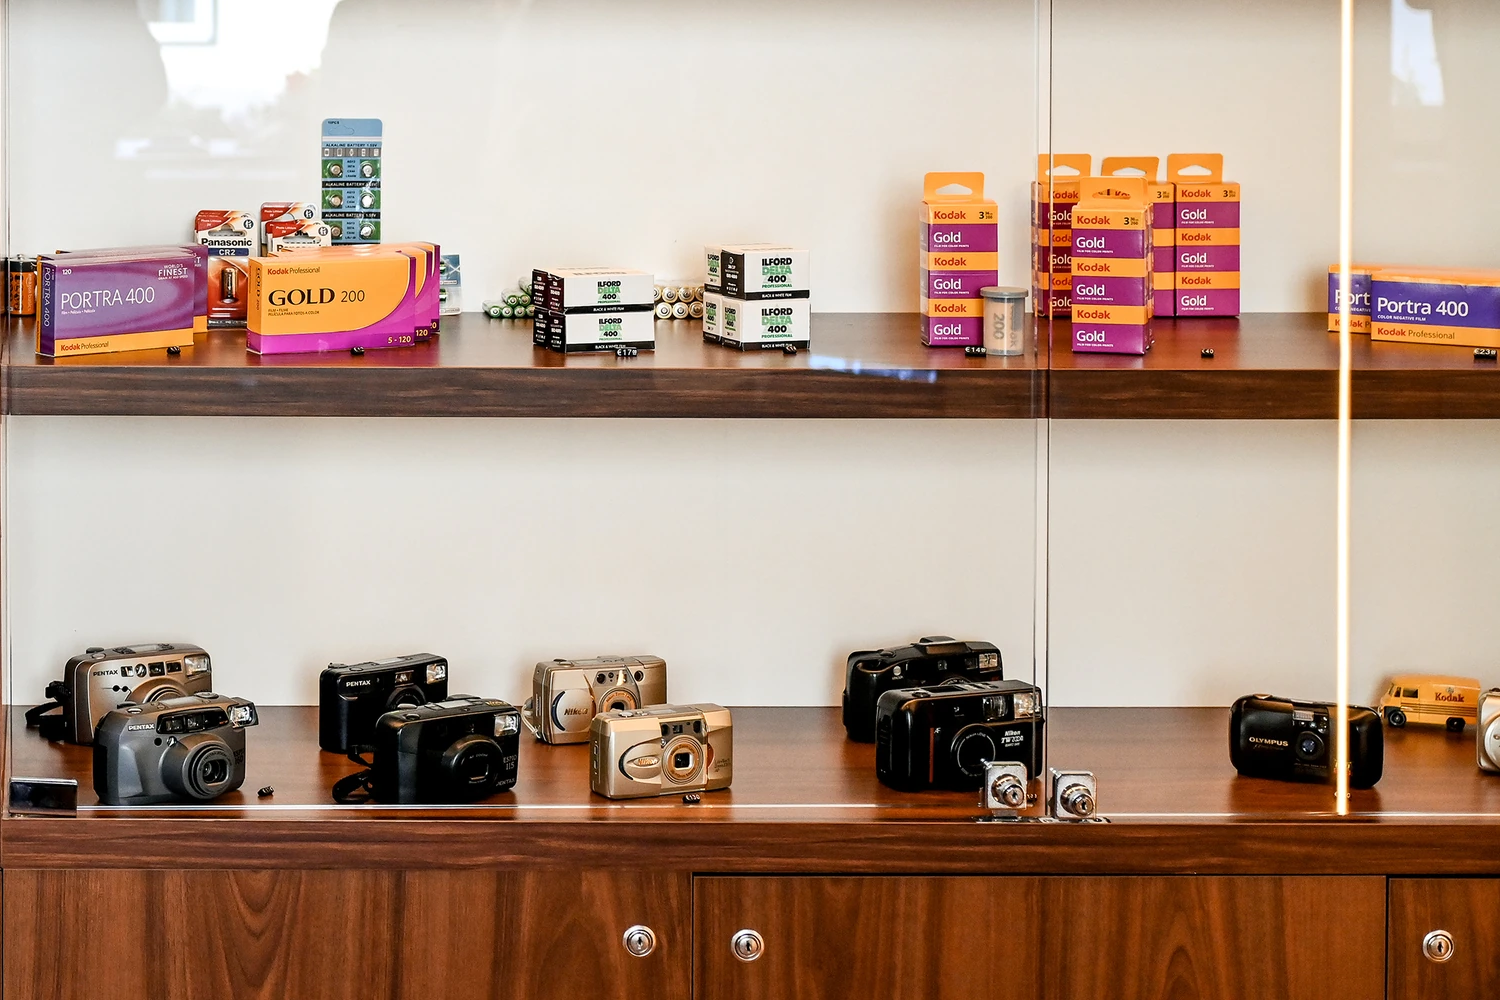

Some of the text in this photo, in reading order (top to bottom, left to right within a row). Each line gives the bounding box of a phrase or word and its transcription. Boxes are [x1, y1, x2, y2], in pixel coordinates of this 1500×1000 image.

[1181, 190, 1212, 198] Kodak
[934, 210, 966, 220] Kodak
[1180, 208, 1206, 220] Gold
[1076, 215, 1110, 225] Kodak
[201, 238, 252, 247] Panasonic
[934, 232, 961, 243] Gold
[1076, 236, 1105, 248] Gold
[1181, 233, 1212, 242] Kodak
[762, 258, 792, 266] ILFORD
[934, 257, 967, 266] Kodak
[1180, 252, 1206, 264] Gold
[158, 268, 188, 276] FINEST
[267, 266, 320, 276] Kodak Professional
[762, 266, 792, 276] DELTA
[1076, 262, 1111, 272] Kodak
[598, 280, 621, 288] ILFORD
[767, 275, 787, 283] 400
[934, 278, 962, 290] Gold
[1181, 276, 1212, 285] Kodak
[1076, 284, 1105, 296] Gold
[61, 286, 155, 310] PORTRA 400
[268, 288, 366, 306] GOLD 200
[1180, 295, 1206, 306] Gold
[761, 308, 793, 316] ILFORD
[934, 304, 967, 312] Kodak
[1377, 297, 1469, 317] Portra 400
[1076, 310, 1111, 320] Kodak
[761, 316, 793, 326] DELTA
[992, 312, 1004, 340] 200
[415, 329, 428, 337] 120
[767, 325, 788, 334] 400
[934, 324, 962, 336] Gold
[1378, 327, 1455, 340] Kodak Professional
[398, 335, 412, 344] 120
[1076, 330, 1106, 342] Gold
[60, 342, 110, 352] Kodak Professional
[92, 669, 118, 677] PENTAX
[1434, 692, 1465, 703] Kodak
[128, 723, 156, 732] PENTAX
[1248, 736, 1289, 747] OLYMPUS
